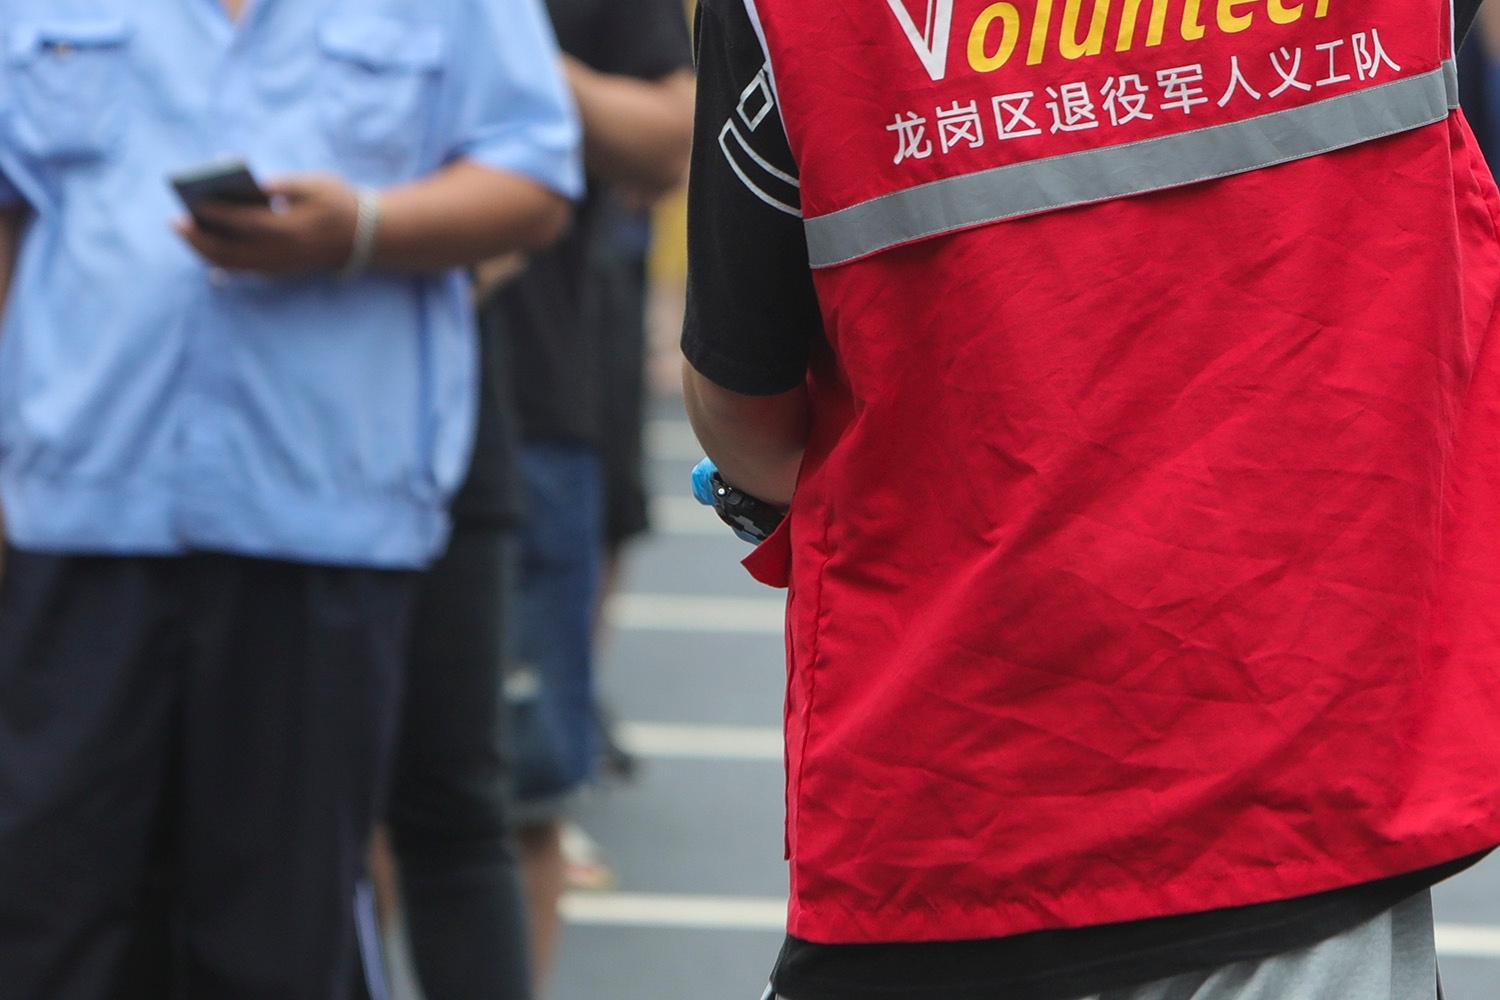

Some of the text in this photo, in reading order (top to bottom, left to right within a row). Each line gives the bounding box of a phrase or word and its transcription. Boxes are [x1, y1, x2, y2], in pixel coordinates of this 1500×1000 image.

[886, 28, 1401, 165] 龙岗区退役军人义工队
